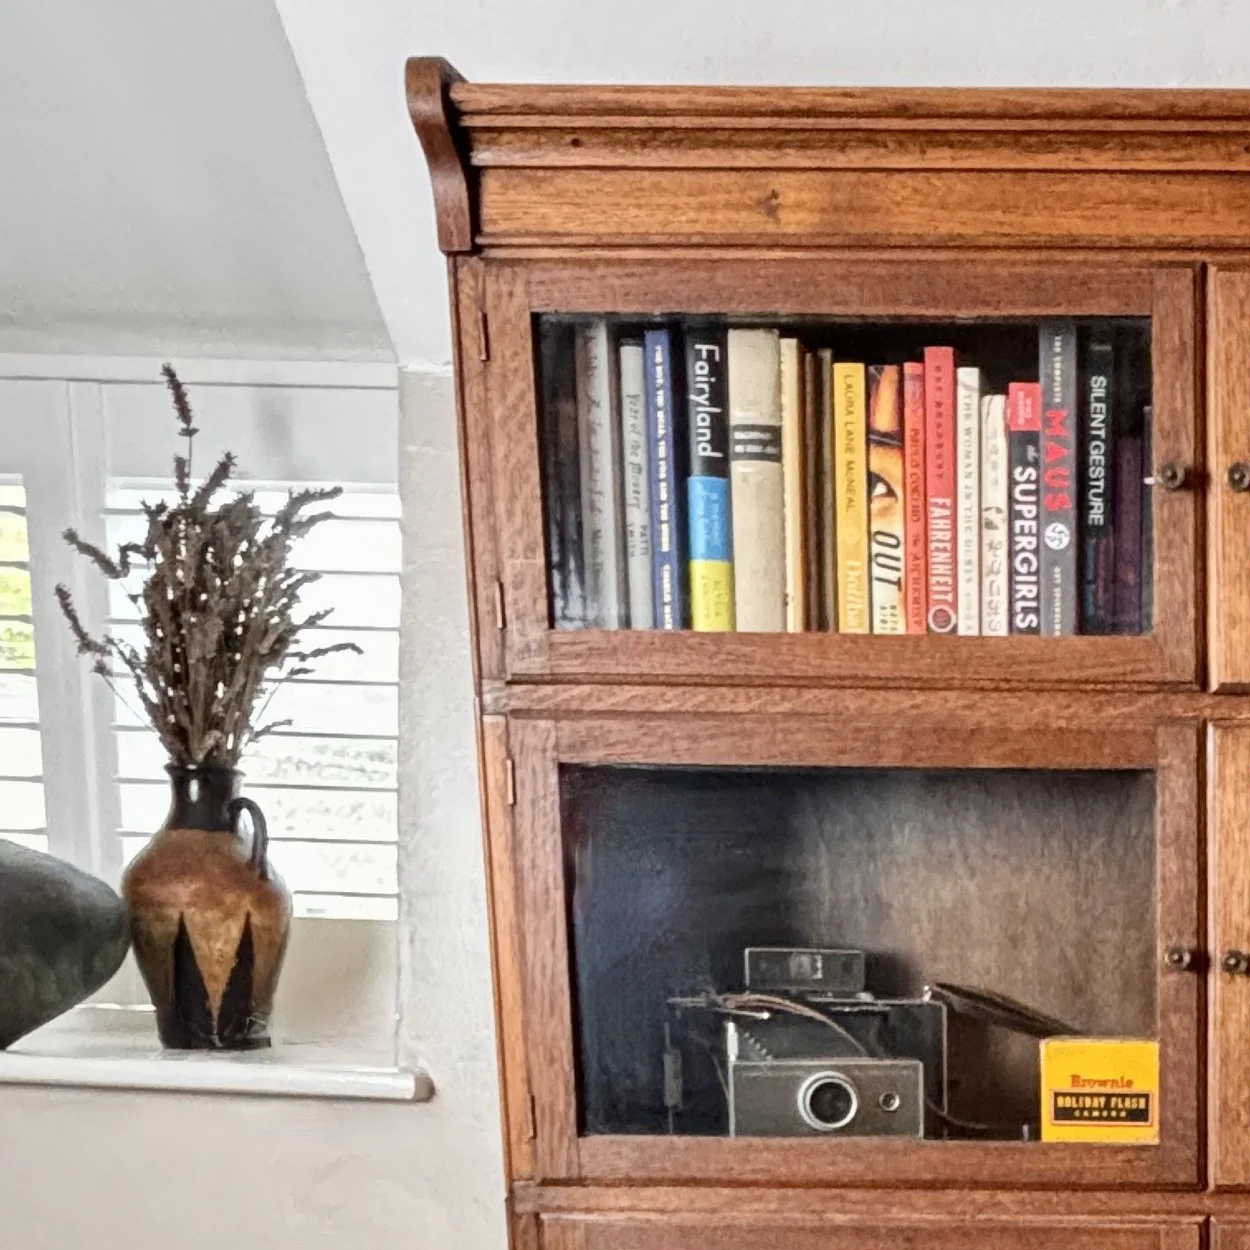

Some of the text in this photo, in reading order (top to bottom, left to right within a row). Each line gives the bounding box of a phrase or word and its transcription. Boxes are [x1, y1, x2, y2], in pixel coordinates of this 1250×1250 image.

[688, 343, 724, 458] Fairyland
[843, 374, 857, 416] LAURA
[1089, 375, 1107, 439] SILENT
[844, 421, 857, 453] LANE
[963, 427, 974, 480] WOMAN
[1042, 408, 1073, 513] MAUS
[1087, 440, 1105, 526] GESTURE
[872, 529, 903, 592] OUT
[928, 496, 954, 604] FAHRENHEIT
[1013, 465, 1039, 629] SUPERGIRLS
[1056, 1095, 1147, 1110] HOLIDAY FLASH
[1069, 1073, 1134, 1089] Brownie
